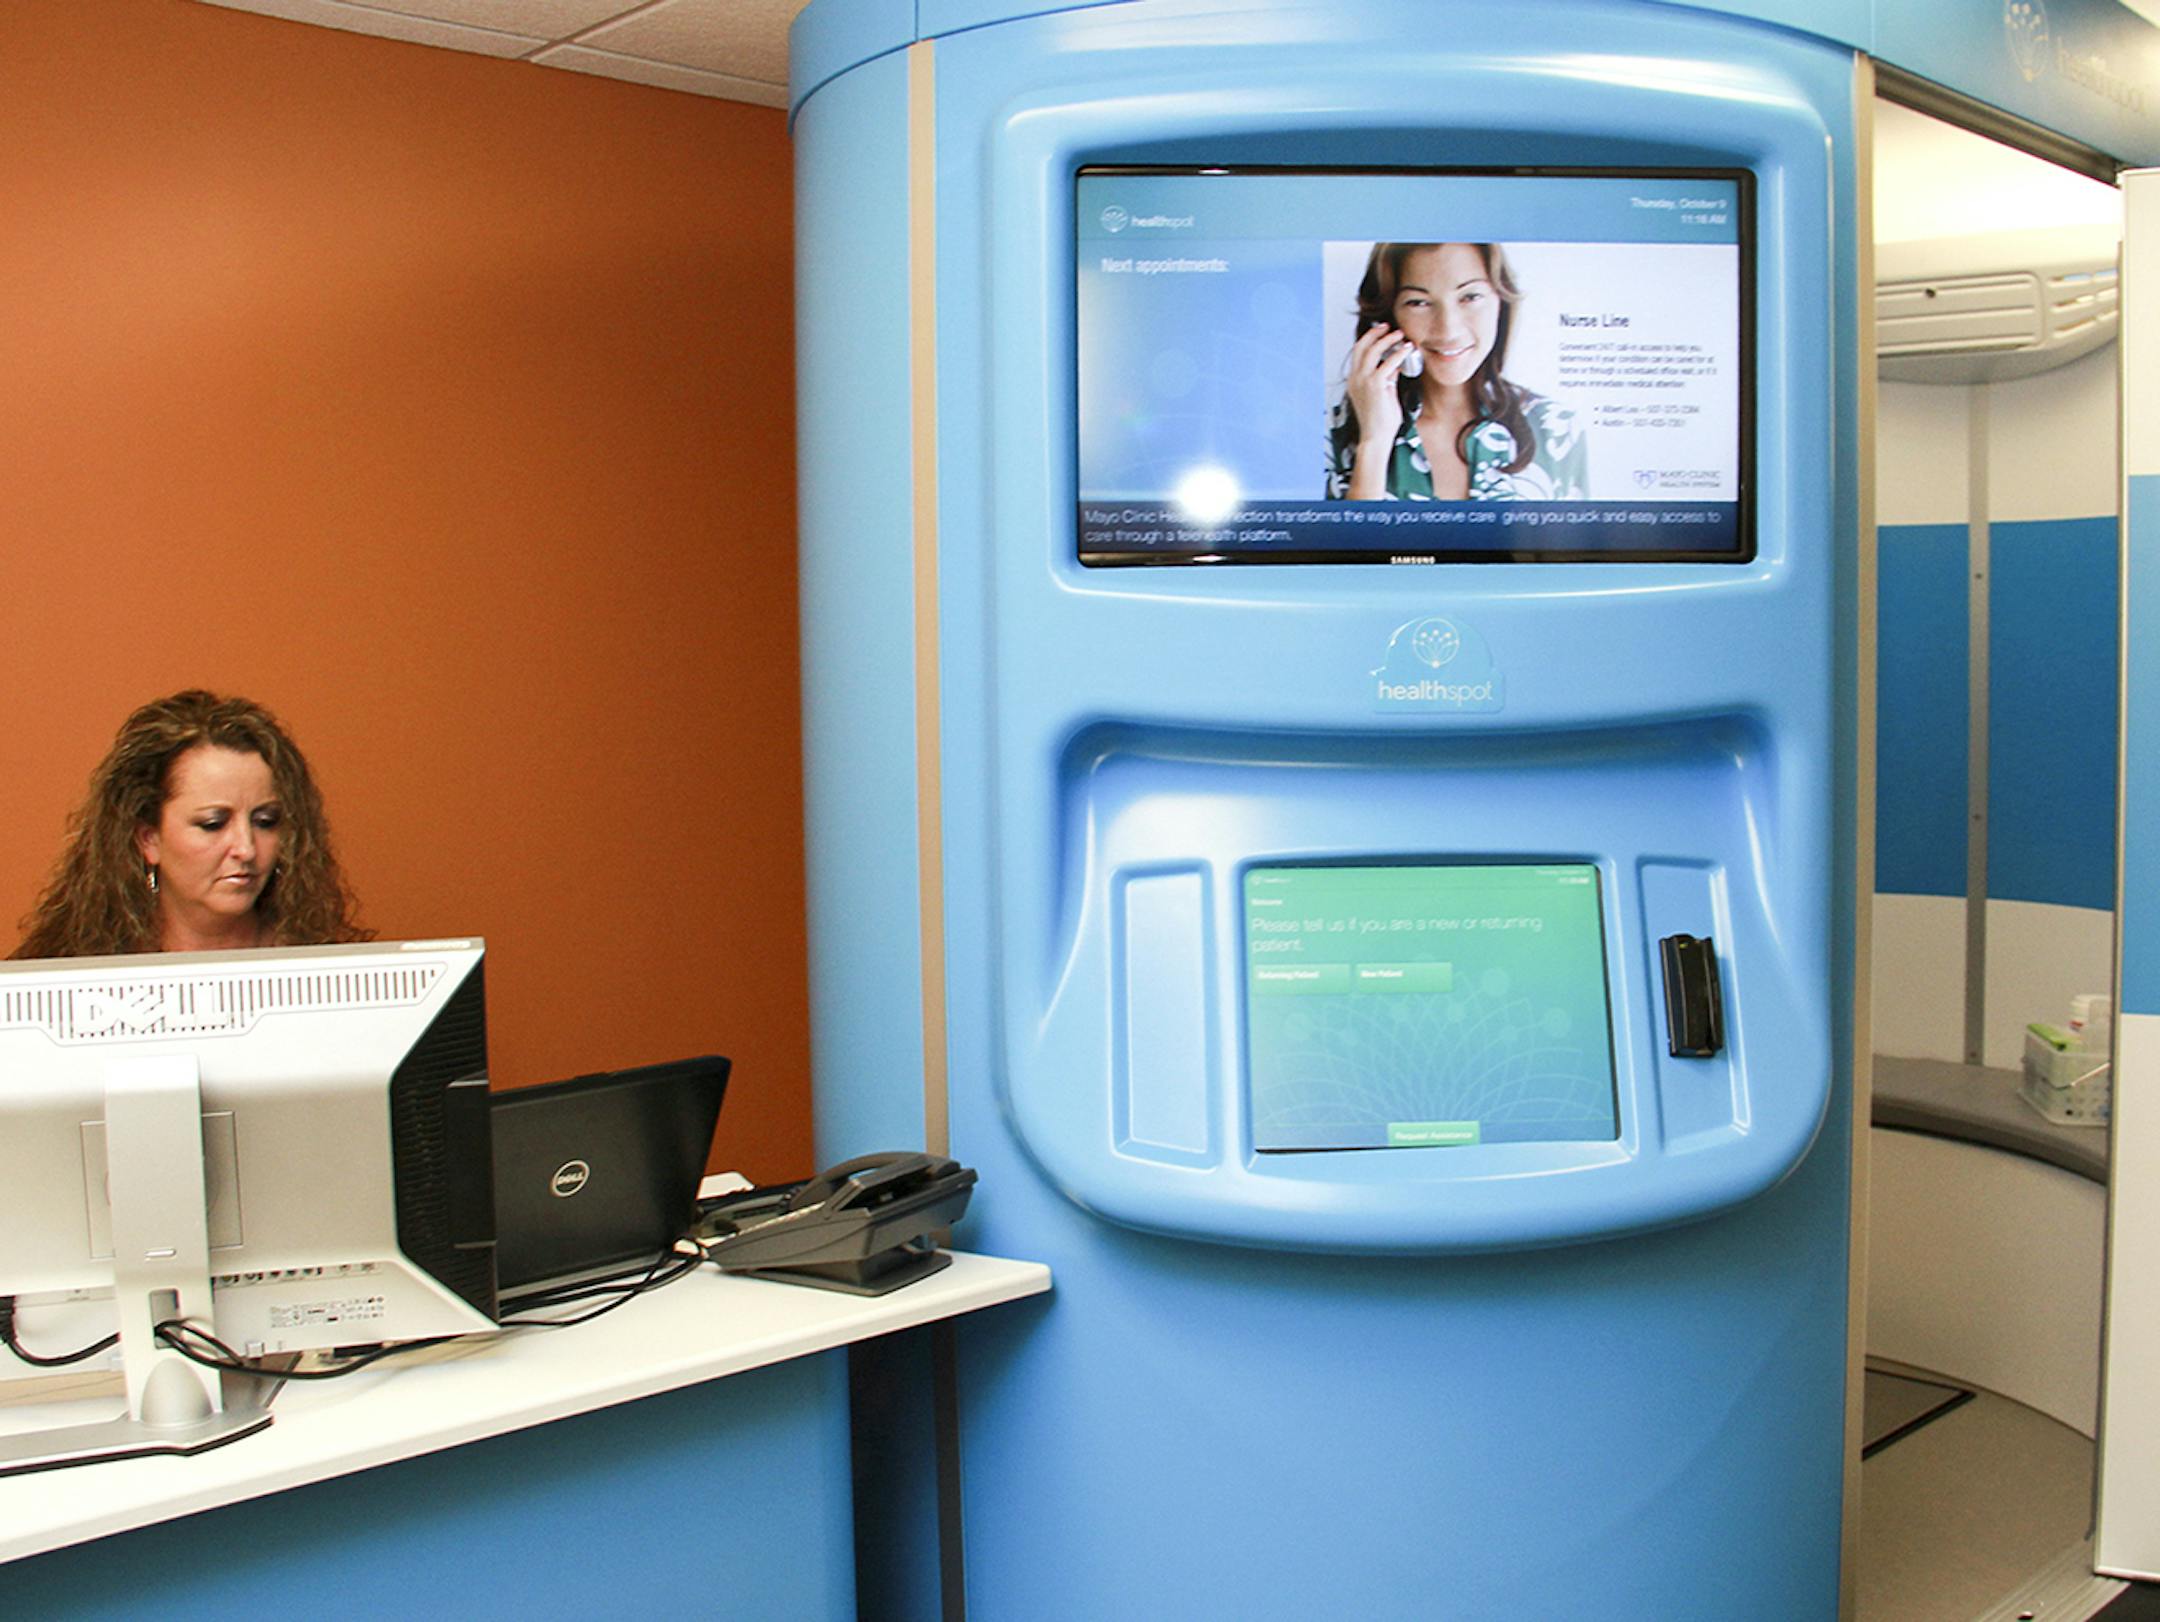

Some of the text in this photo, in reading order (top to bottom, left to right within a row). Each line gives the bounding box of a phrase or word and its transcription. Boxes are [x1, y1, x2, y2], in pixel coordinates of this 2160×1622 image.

[1130, 215, 1195, 230] healthspot
[1708, 213, 1728, 224] AM
[1101, 257, 1230, 275] Next appointments:
[1559, 313, 1630, 327] Nurse Line
[1084, 510, 1120, 525] Mayo
[1121, 509, 1157, 523] Clinic
[1275, 510, 1342, 523] transforms
[1343, 510, 1364, 523] the
[1366, 511, 1392, 525] way
[1394, 511, 1419, 525] you
[1420, 511, 1465, 523] receive
[1467, 511, 1496, 523] care
[1502, 510, 1539, 525] giving
[1540, 511, 1564, 525] you
[1566, 510, 1600, 525] quick
[1603, 510, 1627, 523] and
[1628, 511, 1657, 525] easy
[1660, 511, 1705, 523] access
[1707, 511, 1722, 523] to
[1084, 530, 1113, 542] care
[1115, 529, 1163, 544] through
[1166, 530, 1175, 541] a
[1238, 529, 1293, 543] platform.
[1390, 555, 1436, 565] SAMSUNG
[1377, 680, 1493, 707] healthspot
[1252, 916, 1543, 935] Please tell us if you are a new or returning
[1251, 938, 1304, 954] patient.
[74, 985, 228, 1034] DELL
[556, 1171, 585, 1186] DELL
